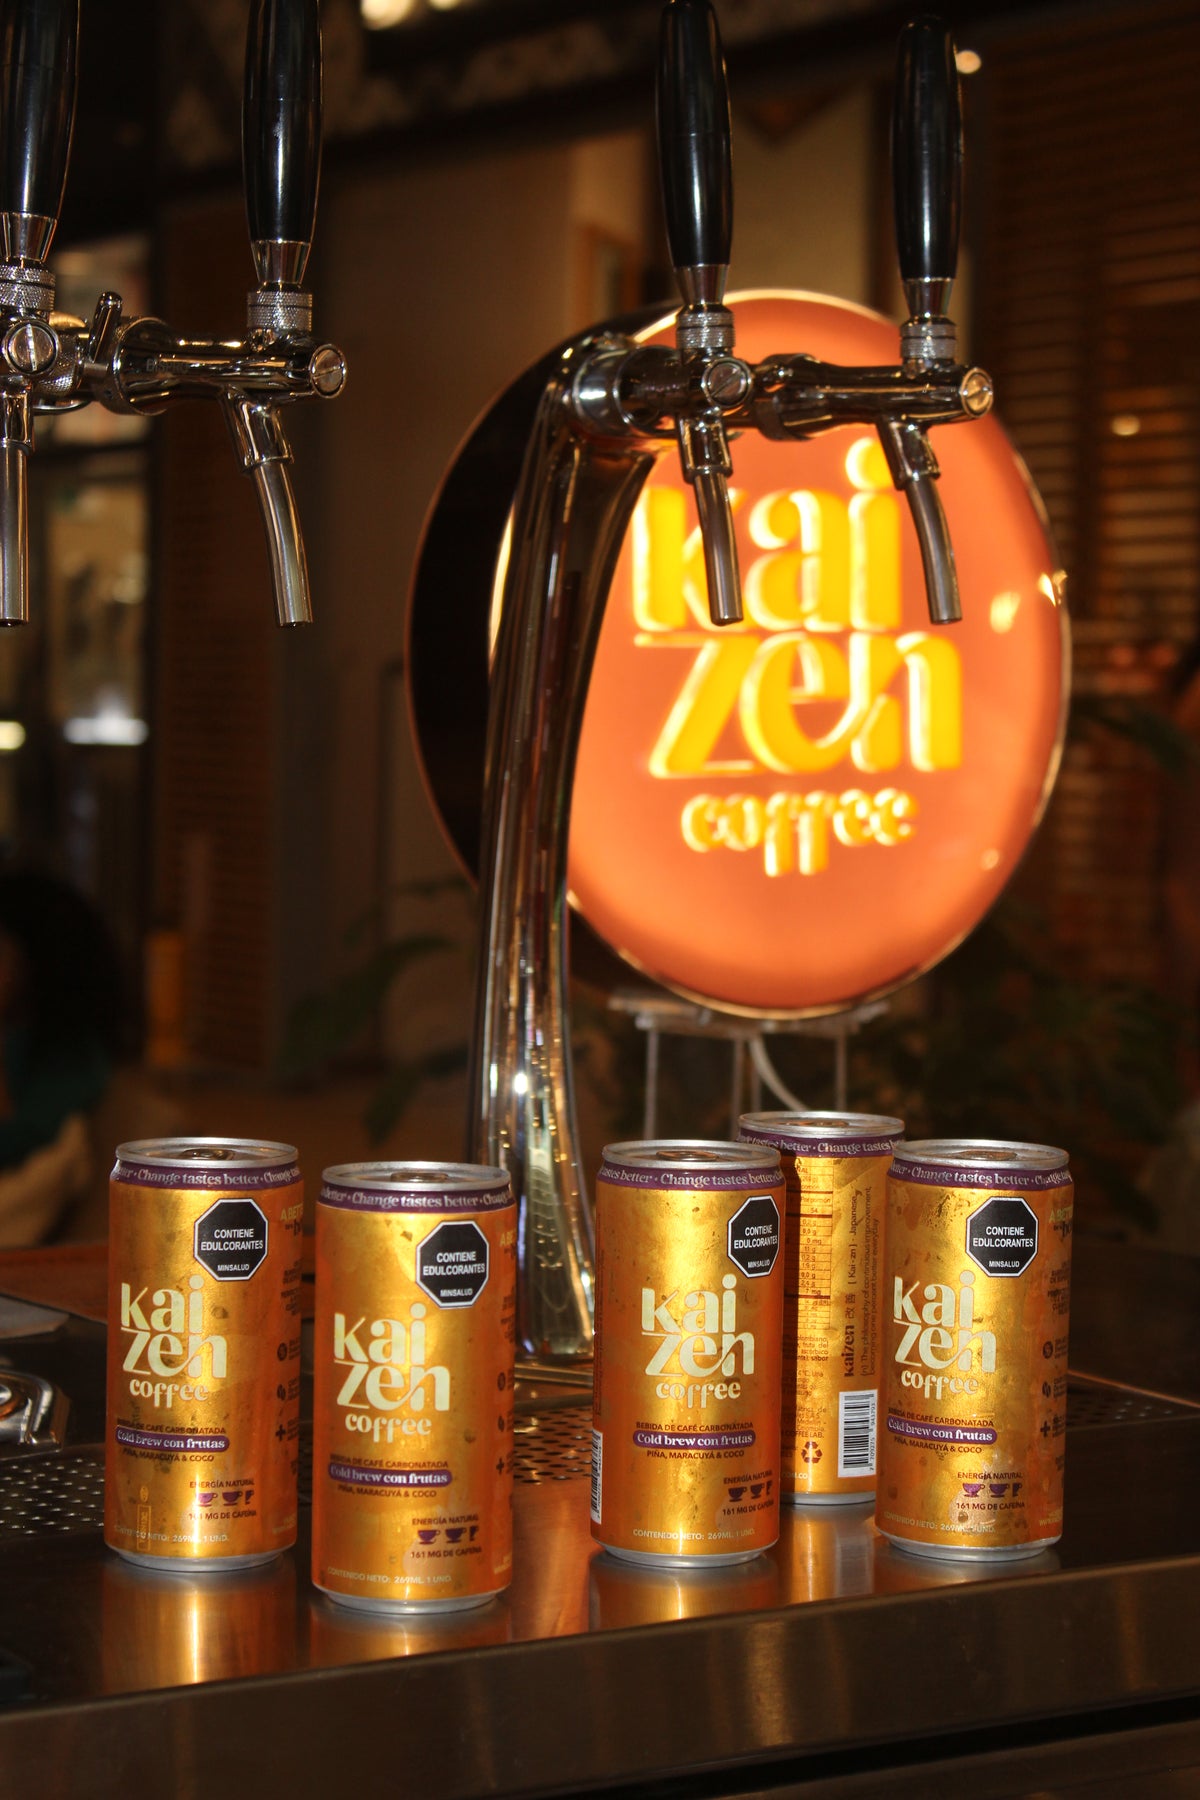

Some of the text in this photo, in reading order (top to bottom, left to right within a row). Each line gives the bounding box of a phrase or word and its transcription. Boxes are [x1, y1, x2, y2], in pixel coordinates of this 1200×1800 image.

[632, 437, 900, 631] kai
[633, 632, 963, 778] zen
[681, 788, 916, 877] coffee
[781, 1139, 811, 1152] better
[818, 1142, 861, 1155] Change
[863, 1141, 890, 1152] tastes
[137, 1168, 180, 1185] Change
[183, 1174, 221, 1185] tastes
[224, 1174, 260, 1185] better
[621, 1169, 652, 1183] better
[660, 1172, 710, 1188] Change
[712, 1174, 748, 1186] tastes
[749, 1172, 774, 1184] better
[911, 1167, 952, 1184] Change
[954, 1172, 992, 1184] tastes
[994, 1173, 1029, 1186] better
[351, 1192, 478, 1209] Change tastes better
[214, 1228, 254, 1239] CONTIENE
[744, 1224, 773, 1236] CONTIENE
[985, 1226, 1025, 1236] CONTIENE
[201, 1240, 264, 1252] EDULCORANTES
[733, 1235, 778, 1249] EDULCORANTES
[972, 1237, 1034, 1248] EDULCORANTES
[436, 1251, 476, 1263] CONTIENE
[747, 1259, 771, 1269] MINSALUD
[988, 1260, 1020, 1268] MINSALUD
[217, 1263, 250, 1272] MINSALUD
[423, 1263, 485, 1276] EDULCORANTES
[440, 1288, 473, 1297] MINSALUD
[893, 1270, 975, 1328] kai
[121, 1275, 204, 1333] kai
[641, 1273, 737, 1333] kai
[334, 1303, 427, 1365] kai
[121, 1327, 227, 1378] zen
[841, 1325, 854, 1377] kaizen
[893, 1319, 997, 1373] zen
[641, 1331, 755, 1378] zen
[334, 1359, 450, 1412] zen
[901, 1370, 979, 1400] coffee
[129, 1379, 209, 1408] coffee
[656, 1381, 741, 1409] coffee
[907, 1412, 994, 1427] DE CAFÉ CARBONATADA
[165, 1426, 226, 1434] CARBONATADA
[345, 1413, 432, 1443] coffee
[636, 1422, 663, 1431] BEBIDA
[677, 1423, 698, 1432] CAFÉ
[699, 1422, 753, 1432] CARBONATADA
[888, 1418, 993, 1441] Cold brew con frutas
[135, 1433, 162, 1446] brew
[164, 1439, 184, 1448] con
[186, 1438, 225, 1449] frutas
[637, 1433, 753, 1446] Cold brew con frutas
[909, 1440, 949, 1452] MARACUYÁ
[647, 1449, 668, 1459] PIÑA,
[669, 1450, 714, 1459] MARACUYÁ
[724, 1449, 745, 1458] COCO
[364, 1458, 383, 1467] CAFÉ
[385, 1460, 448, 1468] CARBONATADA
[330, 1464, 448, 1484] Cold brew con frutas
[957, 1471, 1023, 1480] ENERGÍA NATURAL
[356, 1486, 401, 1497] MARACUYÁ
[412, 1489, 437, 1497] COCO
[722, 1508, 735, 1516] 161
[956, 1502, 970, 1510] 161
[205, 1512, 219, 1520] MG
[412, 1516, 447, 1525] ENERGÍA
[633, 1528, 679, 1539] CONTENIDO
[427, 1550, 441, 1558] MG
[443, 1549, 453, 1557] DE
